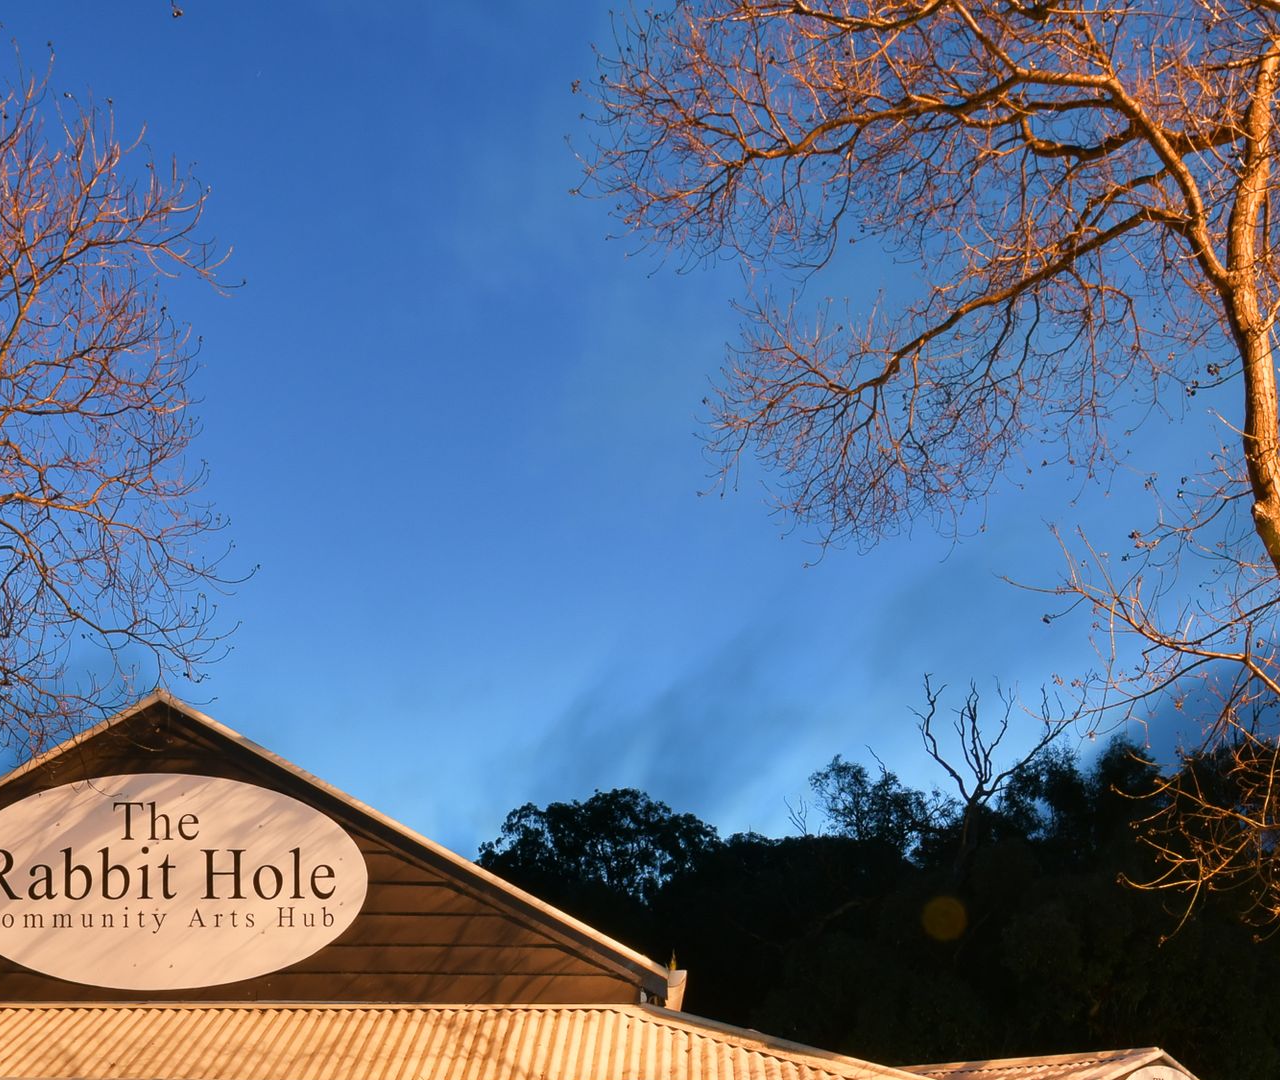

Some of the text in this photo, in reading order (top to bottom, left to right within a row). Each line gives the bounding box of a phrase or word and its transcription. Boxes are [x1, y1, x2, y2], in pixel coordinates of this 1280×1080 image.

[113, 801, 200, 841] The
[200, 847, 336, 900] Hole
[189, 908, 256, 928] Arts
[277, 907, 335, 928] Hub
